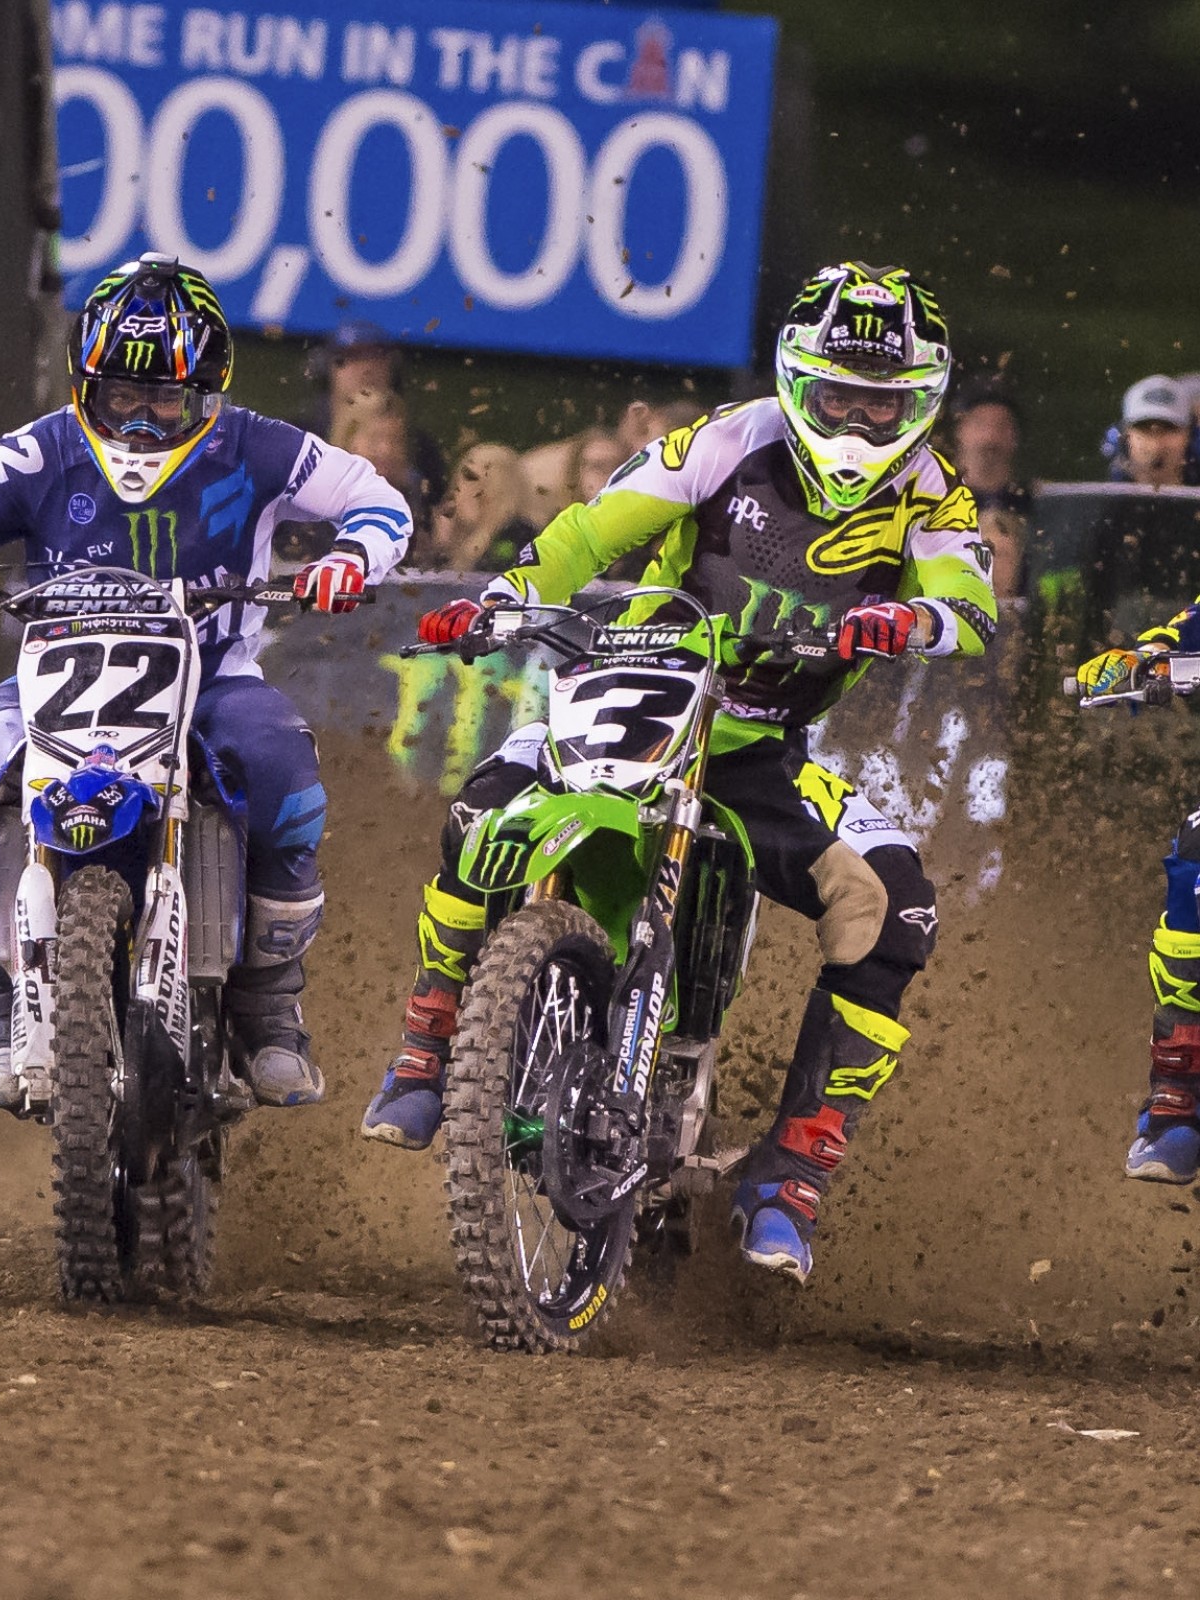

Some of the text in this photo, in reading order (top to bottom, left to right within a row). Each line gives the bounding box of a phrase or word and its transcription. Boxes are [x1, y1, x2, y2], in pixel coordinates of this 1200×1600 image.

[51, 2, 166, 67] ME
[181, 8, 328, 80] RUN
[342, 20, 416, 87] IN
[431, 28, 559, 98] THE
[855, 288, 890, 301] BELL
[87, 541, 114, 558] FLY
[81, 617, 141, 629] MONSTER
[34, 641, 182, 733] 22
[557, 672, 697, 767] 3
[61, 814, 107, 830] YAMAHA
[17, 898, 43, 1024] DUOP
[620, 988, 641, 1058] CARRILLO
[634, 971, 666, 1101] DUNLOP
[568, 1283, 608, 1330] DUNLOP
